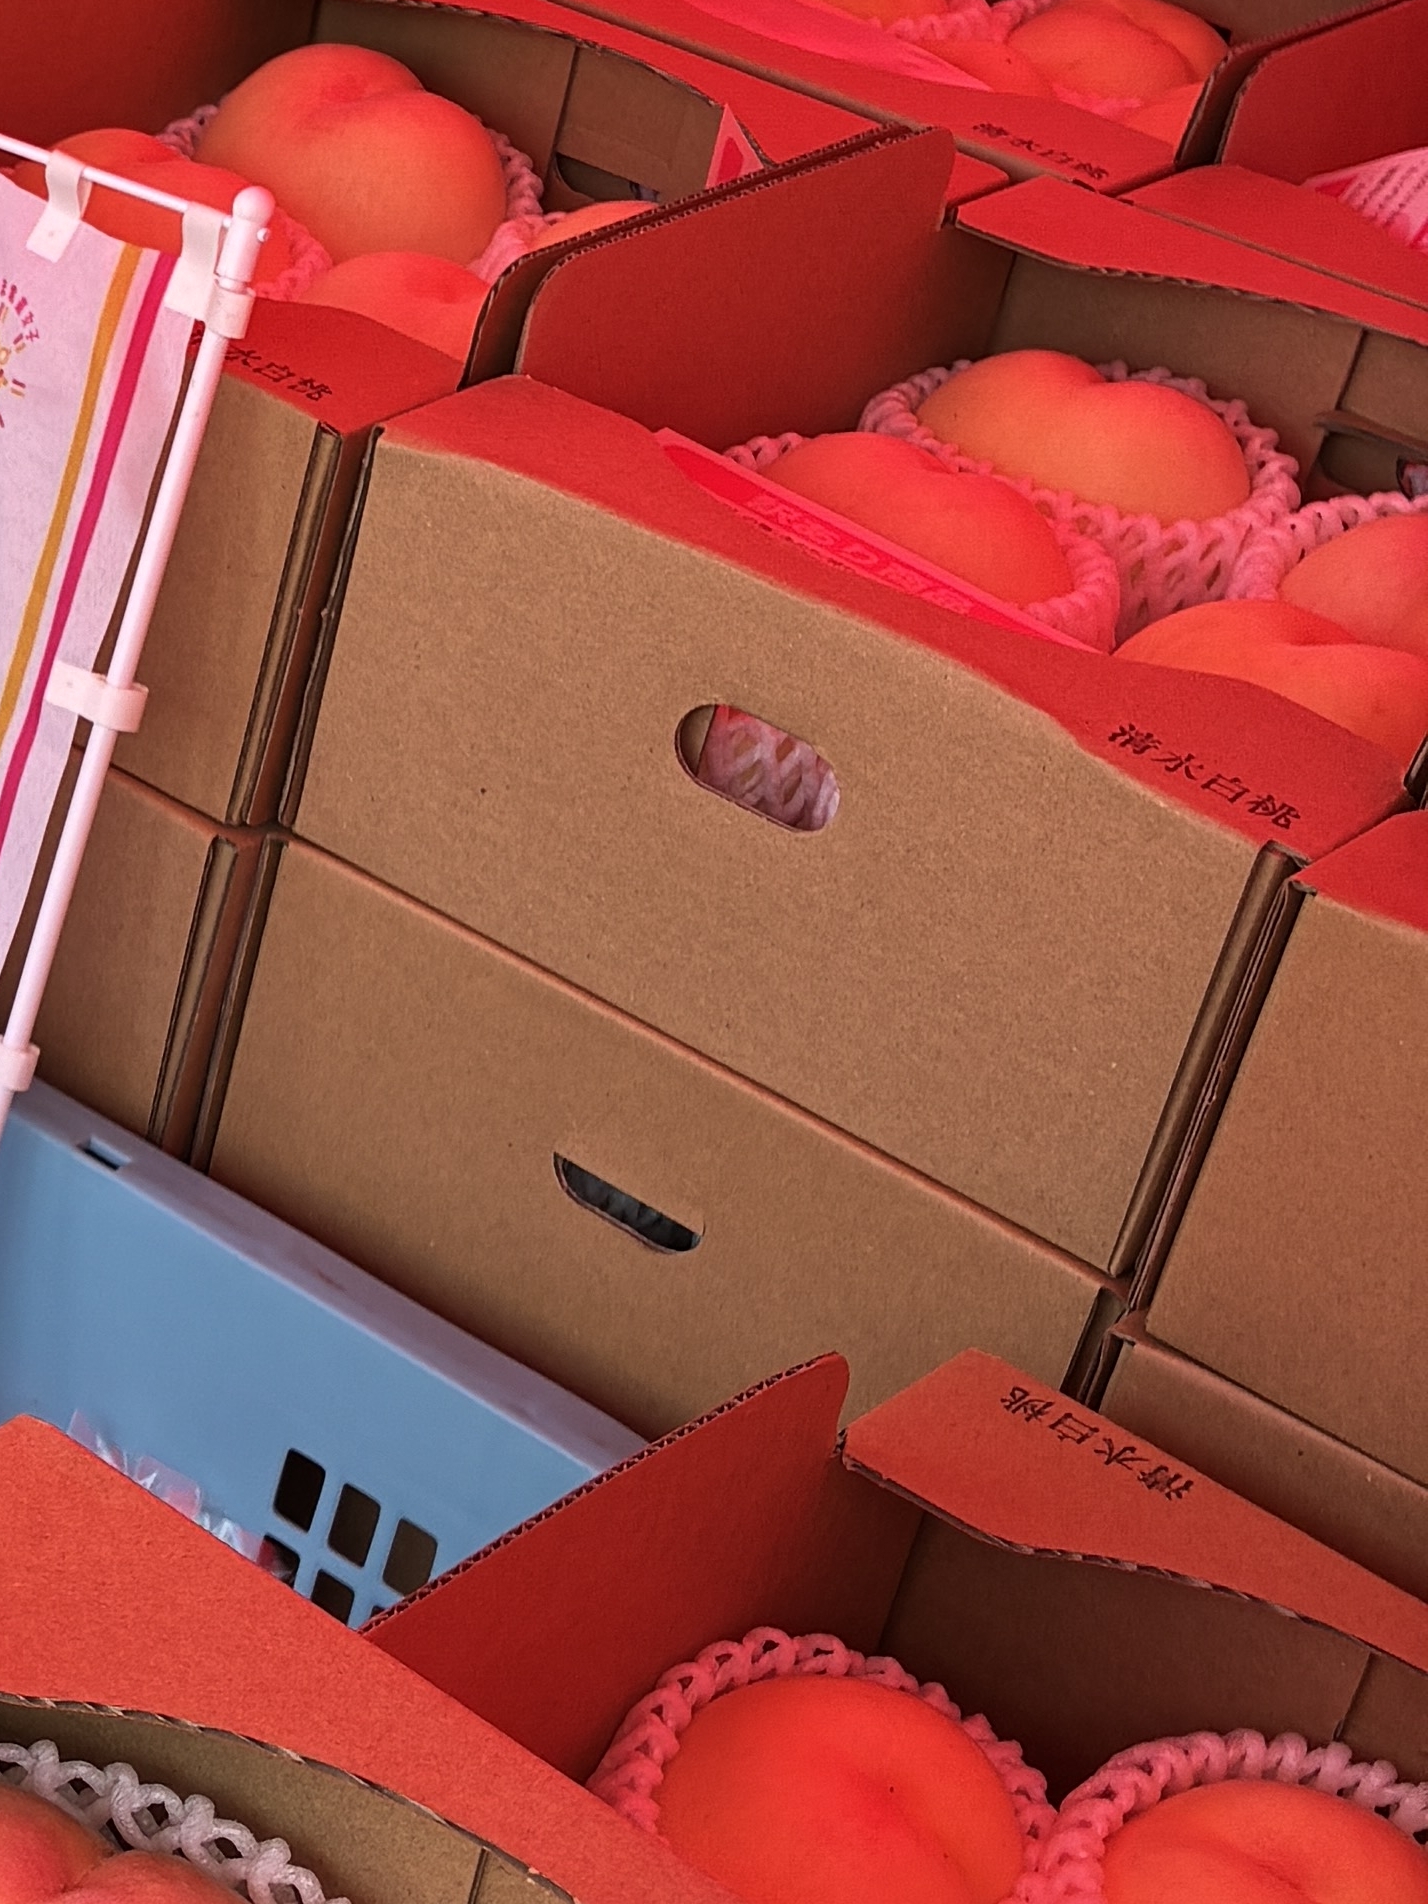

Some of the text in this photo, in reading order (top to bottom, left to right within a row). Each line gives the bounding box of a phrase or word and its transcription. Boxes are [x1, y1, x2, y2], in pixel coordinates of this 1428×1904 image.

[1107, 723, 1301, 830] 清水白桃
[1000, 1385, 1194, 1502] 清水白桃
